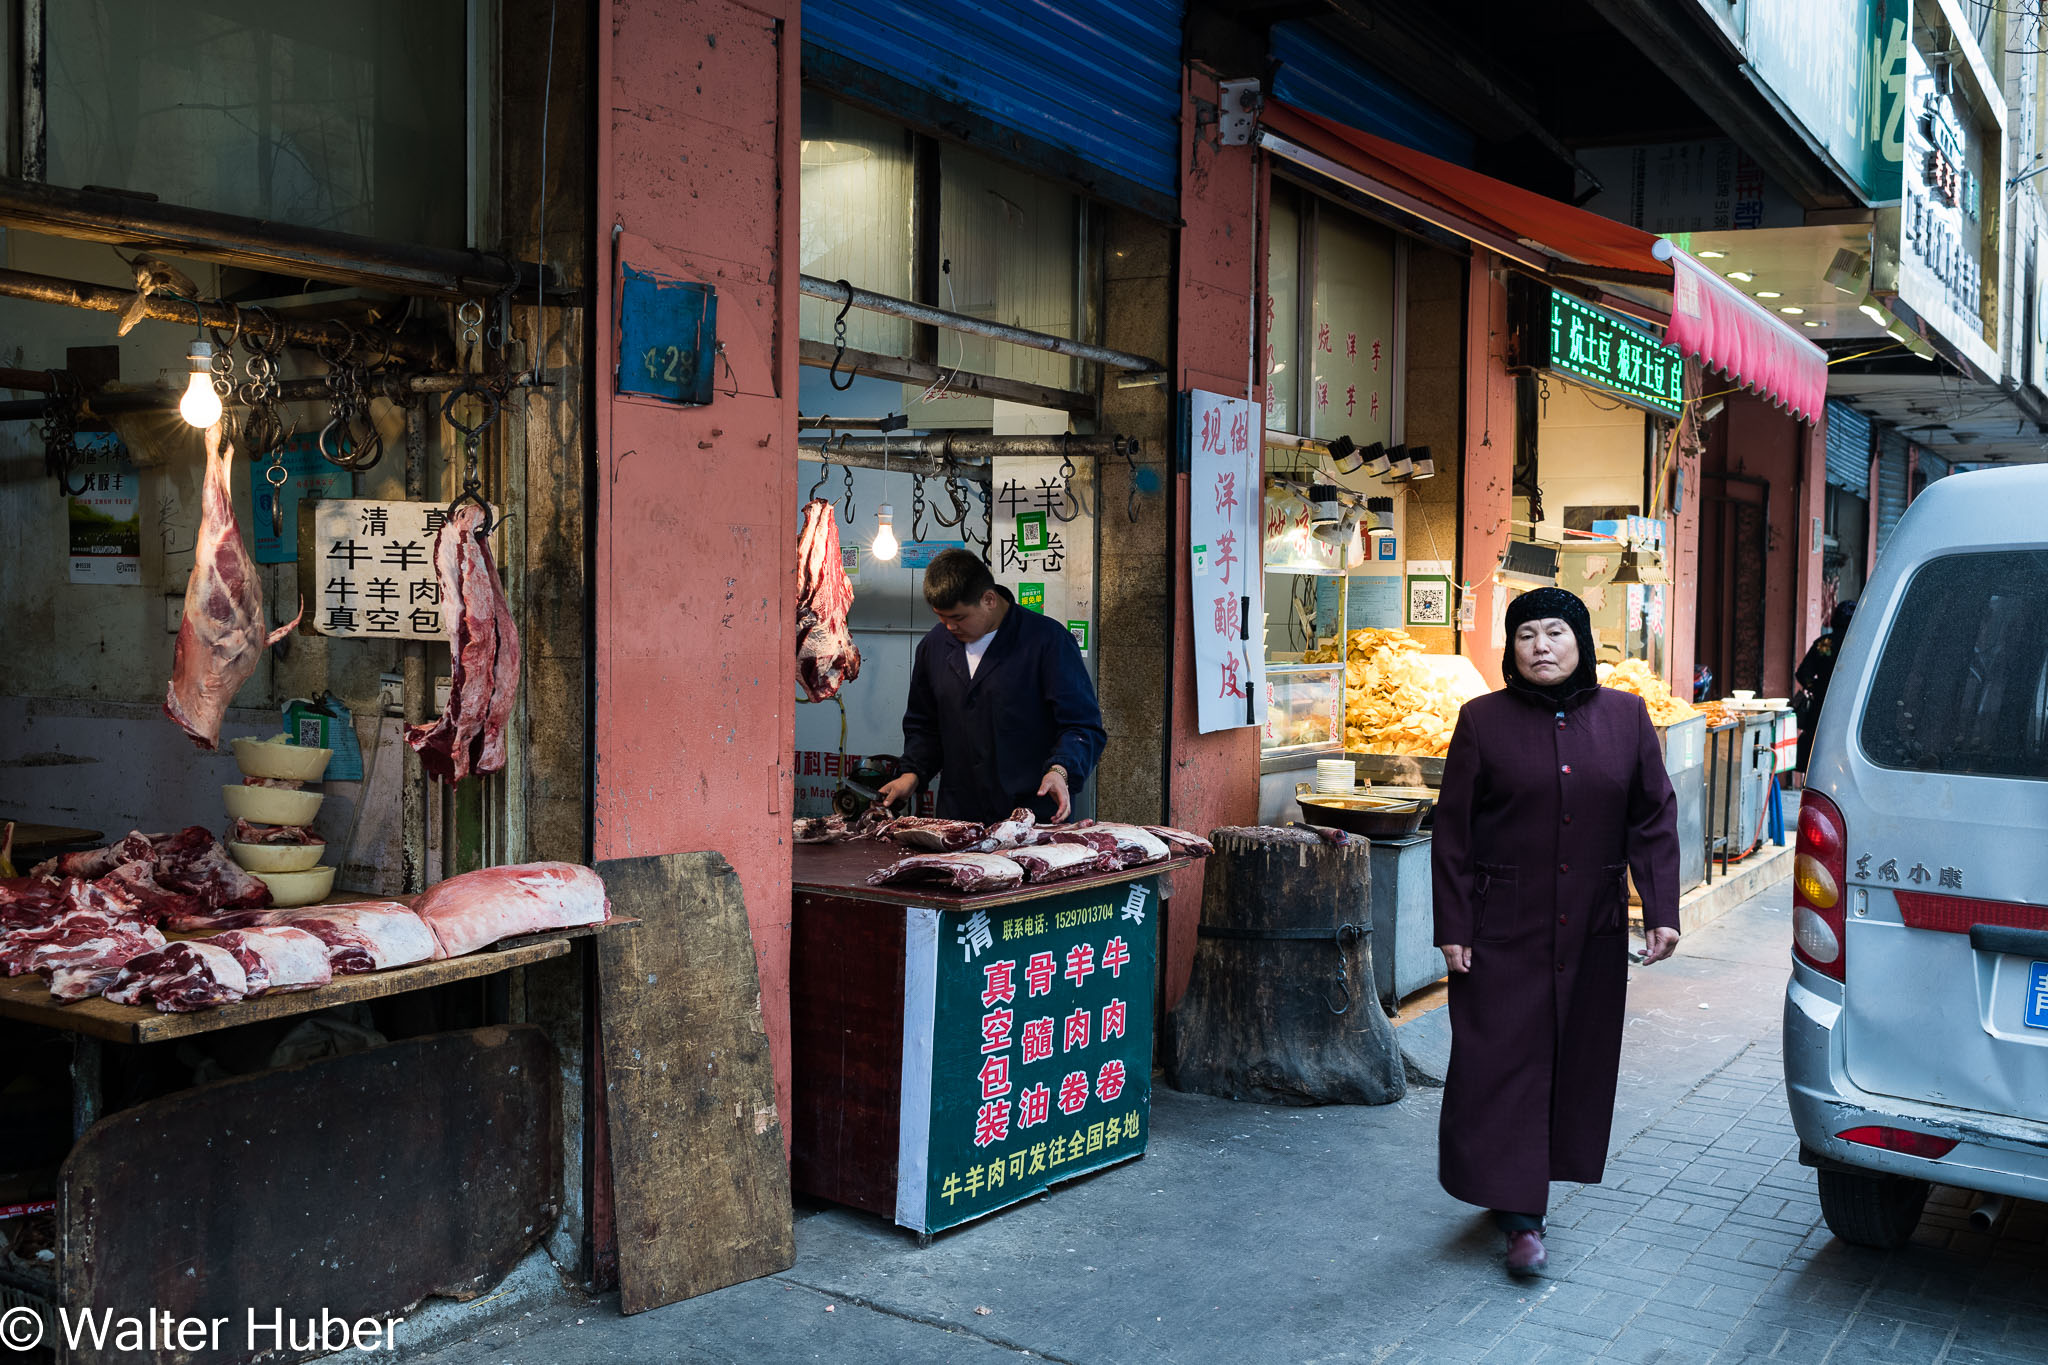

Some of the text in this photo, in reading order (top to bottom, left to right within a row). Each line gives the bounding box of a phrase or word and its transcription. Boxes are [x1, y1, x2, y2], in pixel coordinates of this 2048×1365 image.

[1318, 322, 1381, 372] 炕洋芋
[1317, 383, 1379, 423] 洋芋片
[998, 476, 1064, 518] 牛羊
[1267, 504, 1334, 556] 炒凉
[325, 576, 440, 605] 牛羊肉
[1214, 471, 1248, 699] 洋芋酿皮
[323, 606, 441, 633] 真空包
[1855, 852, 1963, 889] 东风小康
[1055, 903, 1113, 929] 15297013704
[941, 1109, 1140, 1205] 牛羊肉可发往全国各地
